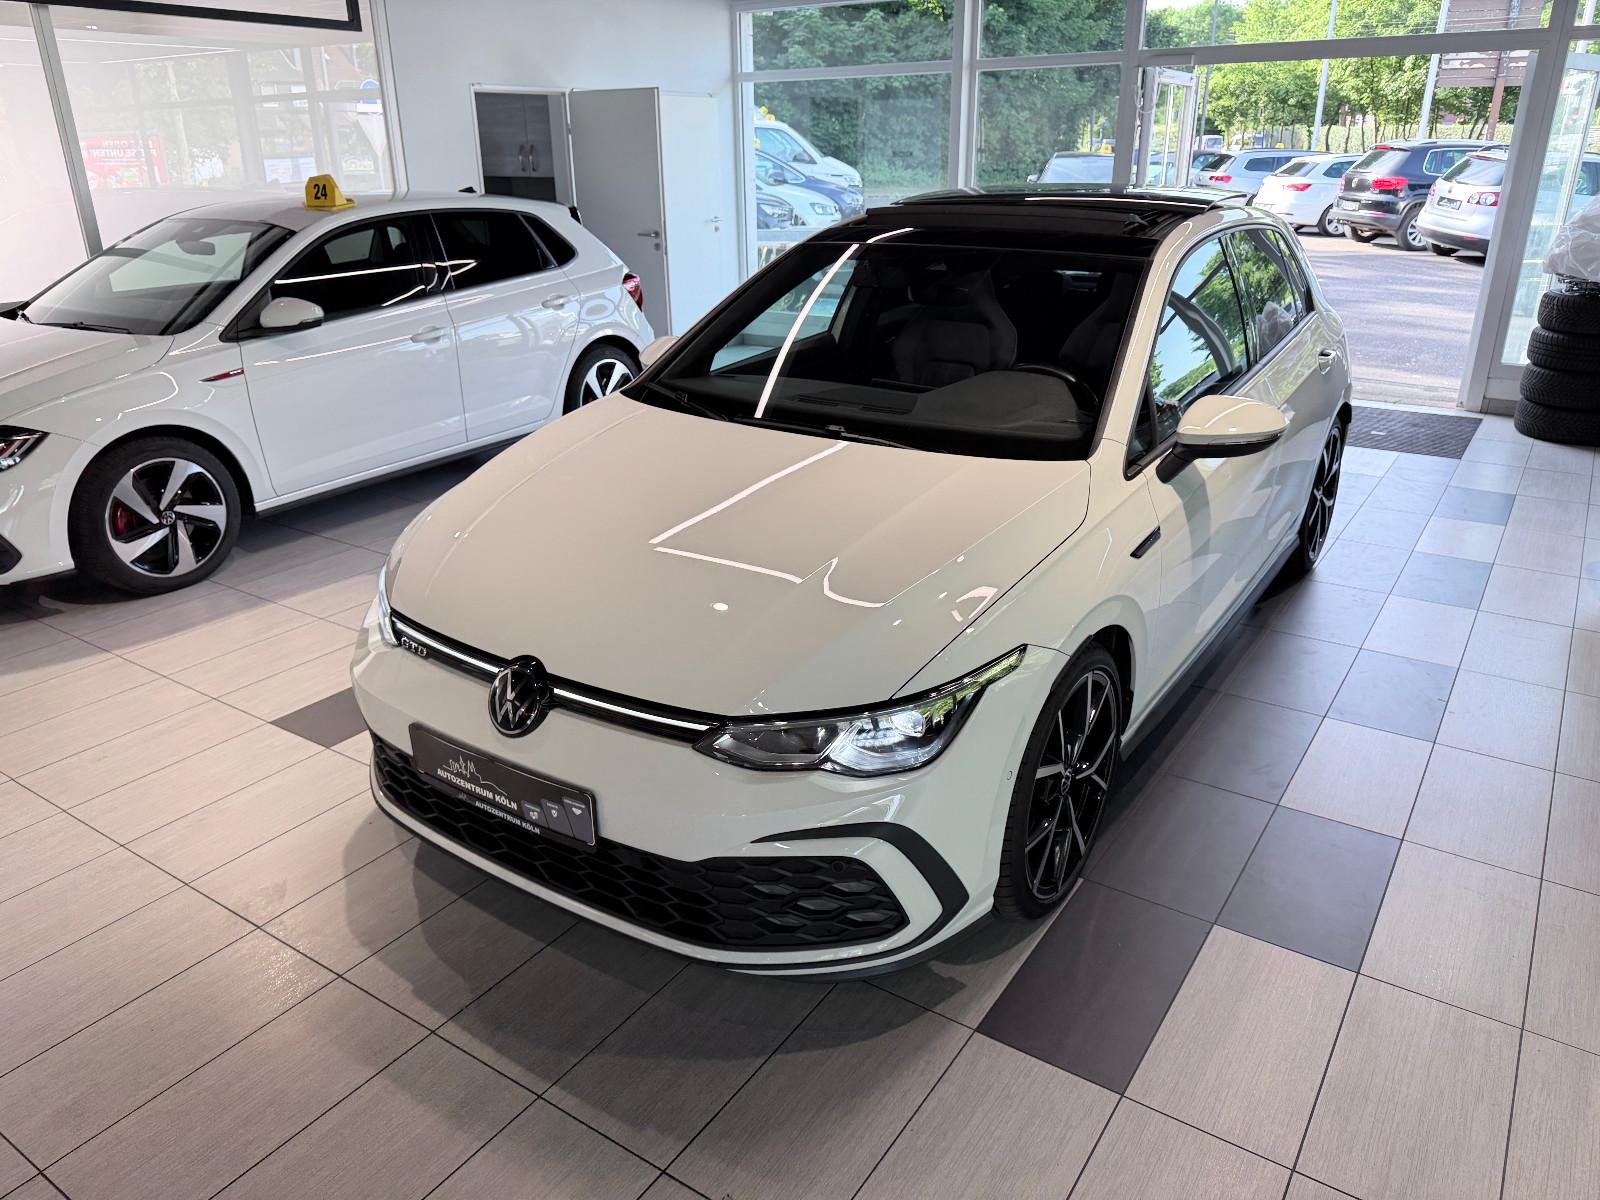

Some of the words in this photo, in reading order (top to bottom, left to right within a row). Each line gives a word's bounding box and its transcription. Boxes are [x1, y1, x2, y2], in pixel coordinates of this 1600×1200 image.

[313, 183, 328, 200] 24
[400, 636, 427, 657] GTD
[437, 768, 494, 800] AUTOZENTRUM
[494, 793, 518, 811] KÖLN
[475, 800, 521, 827] AUTOZENTRUM
